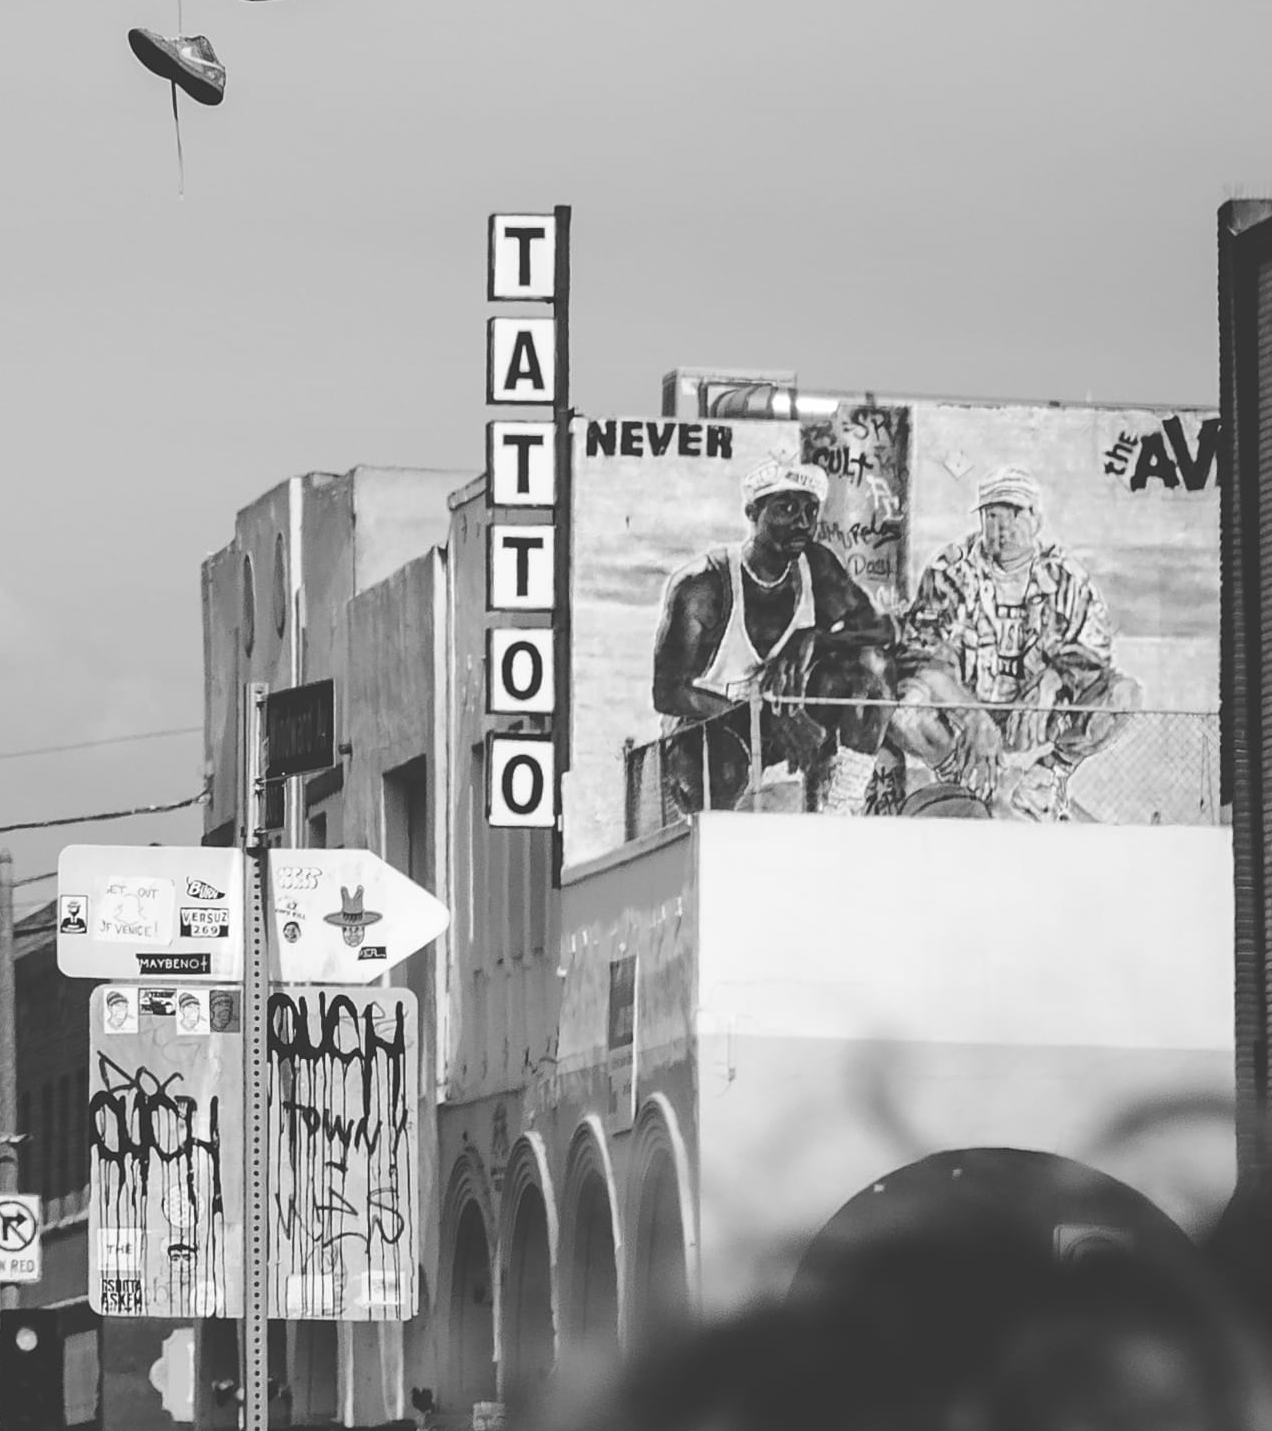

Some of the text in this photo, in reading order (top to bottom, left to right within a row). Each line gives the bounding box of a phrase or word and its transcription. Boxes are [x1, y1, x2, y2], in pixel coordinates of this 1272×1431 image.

[586, 420, 733, 459] NEVER
[1130, 416, 1222, 491] AV
[501, 227, 545, 815] TATTOO
[106, 884, 127, 895] ET
[192, 925, 219, 936] 269
[10, 1258, 35, 1274] RED
